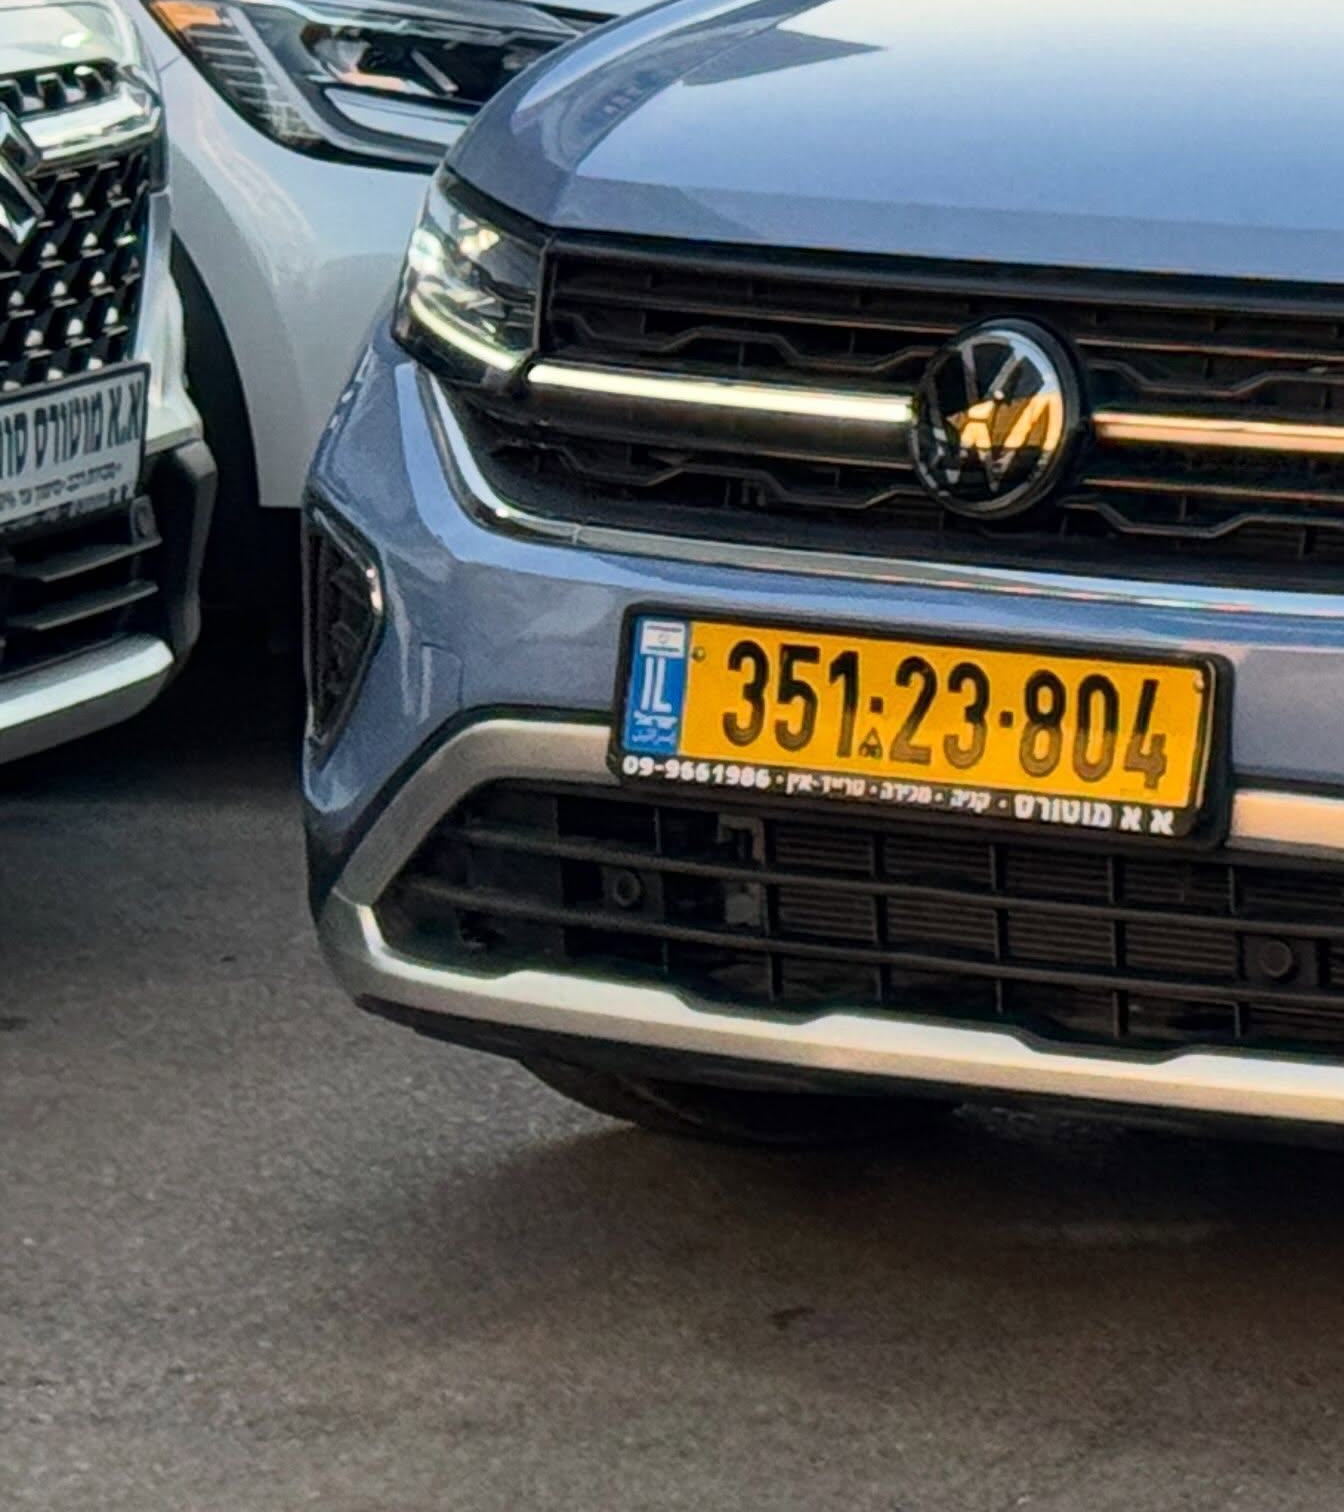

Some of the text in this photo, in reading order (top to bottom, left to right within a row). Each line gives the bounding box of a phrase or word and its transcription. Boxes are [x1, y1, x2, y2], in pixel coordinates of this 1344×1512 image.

[640, 656, 673, 713] IL
[621, 754, 771, 789] 09-9661986
[1013, 792, 1113, 828] מוטורס
